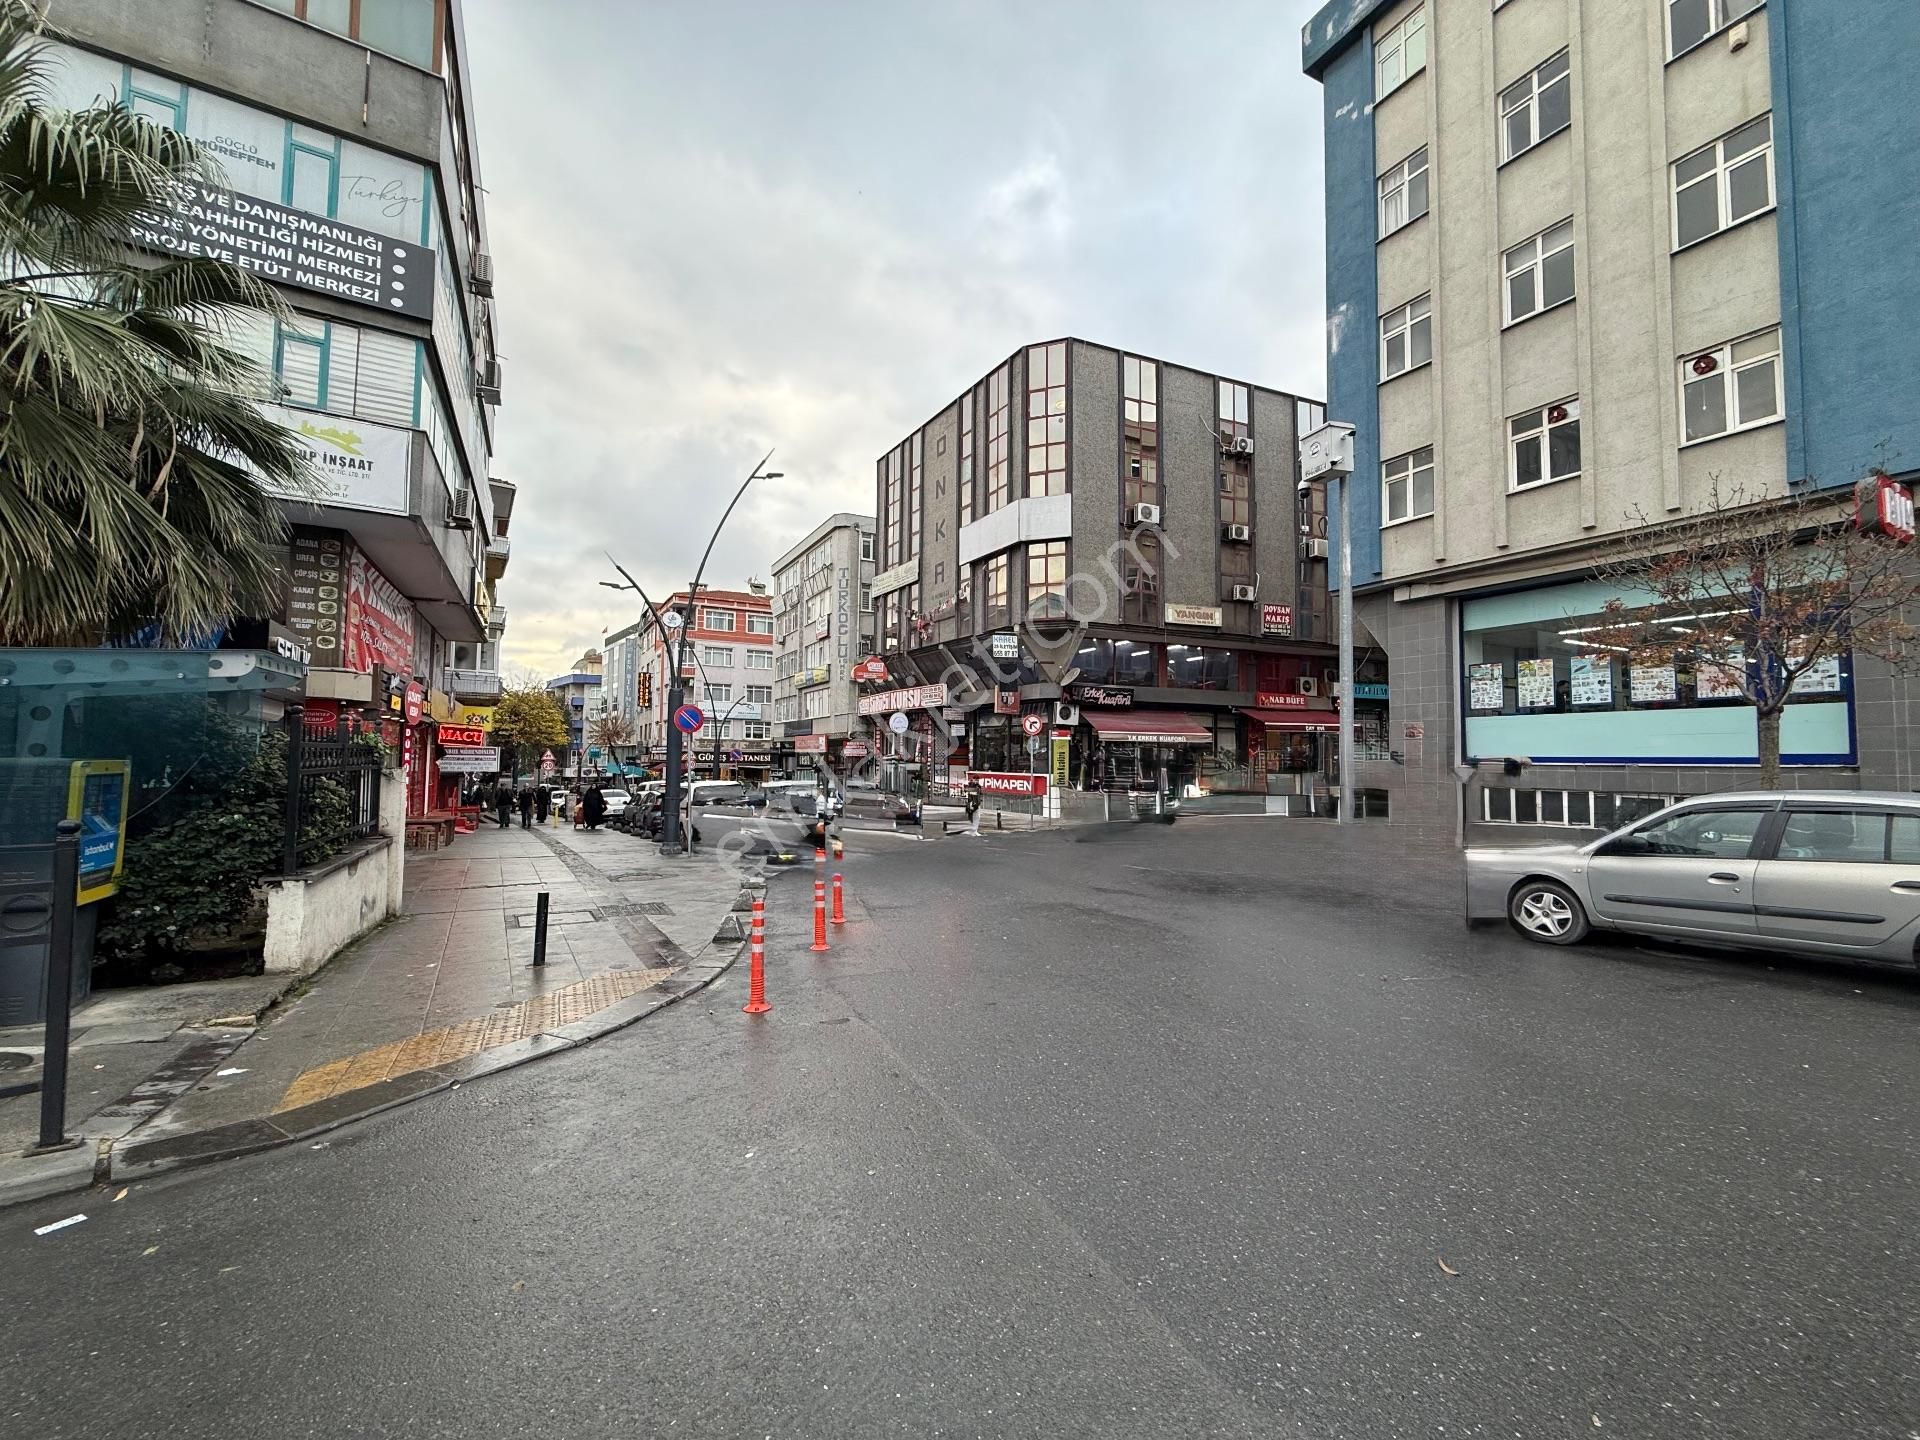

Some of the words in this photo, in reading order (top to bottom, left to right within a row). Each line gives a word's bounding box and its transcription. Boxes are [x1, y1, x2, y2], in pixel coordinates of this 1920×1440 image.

[194, 137, 276, 170] MÜREFFEH
[215, 135, 258, 155] GÜÇLÜ
[340, 175, 424, 218] Türkiye
[201, 189, 230, 208] VE
[234, 199, 382, 252] DANIŞMANLIĞI
[188, 222, 292, 261] YÖNETİMİ
[297, 253, 381, 286] MERKEZİ
[302, 236, 381, 269] HİZMETİ
[204, 245, 233, 264] VE
[238, 254, 292, 279] ETÜT
[295, 270, 380, 302] MERKEZİ
[323, 451, 374, 472] İNŞAAT
[890, 689, 921, 710] KURSU
[1269, 695, 1284, 704] NAR
[1286, 695, 1305, 705] BÜFE
[984, 777, 1032, 792] PİMAPEN
